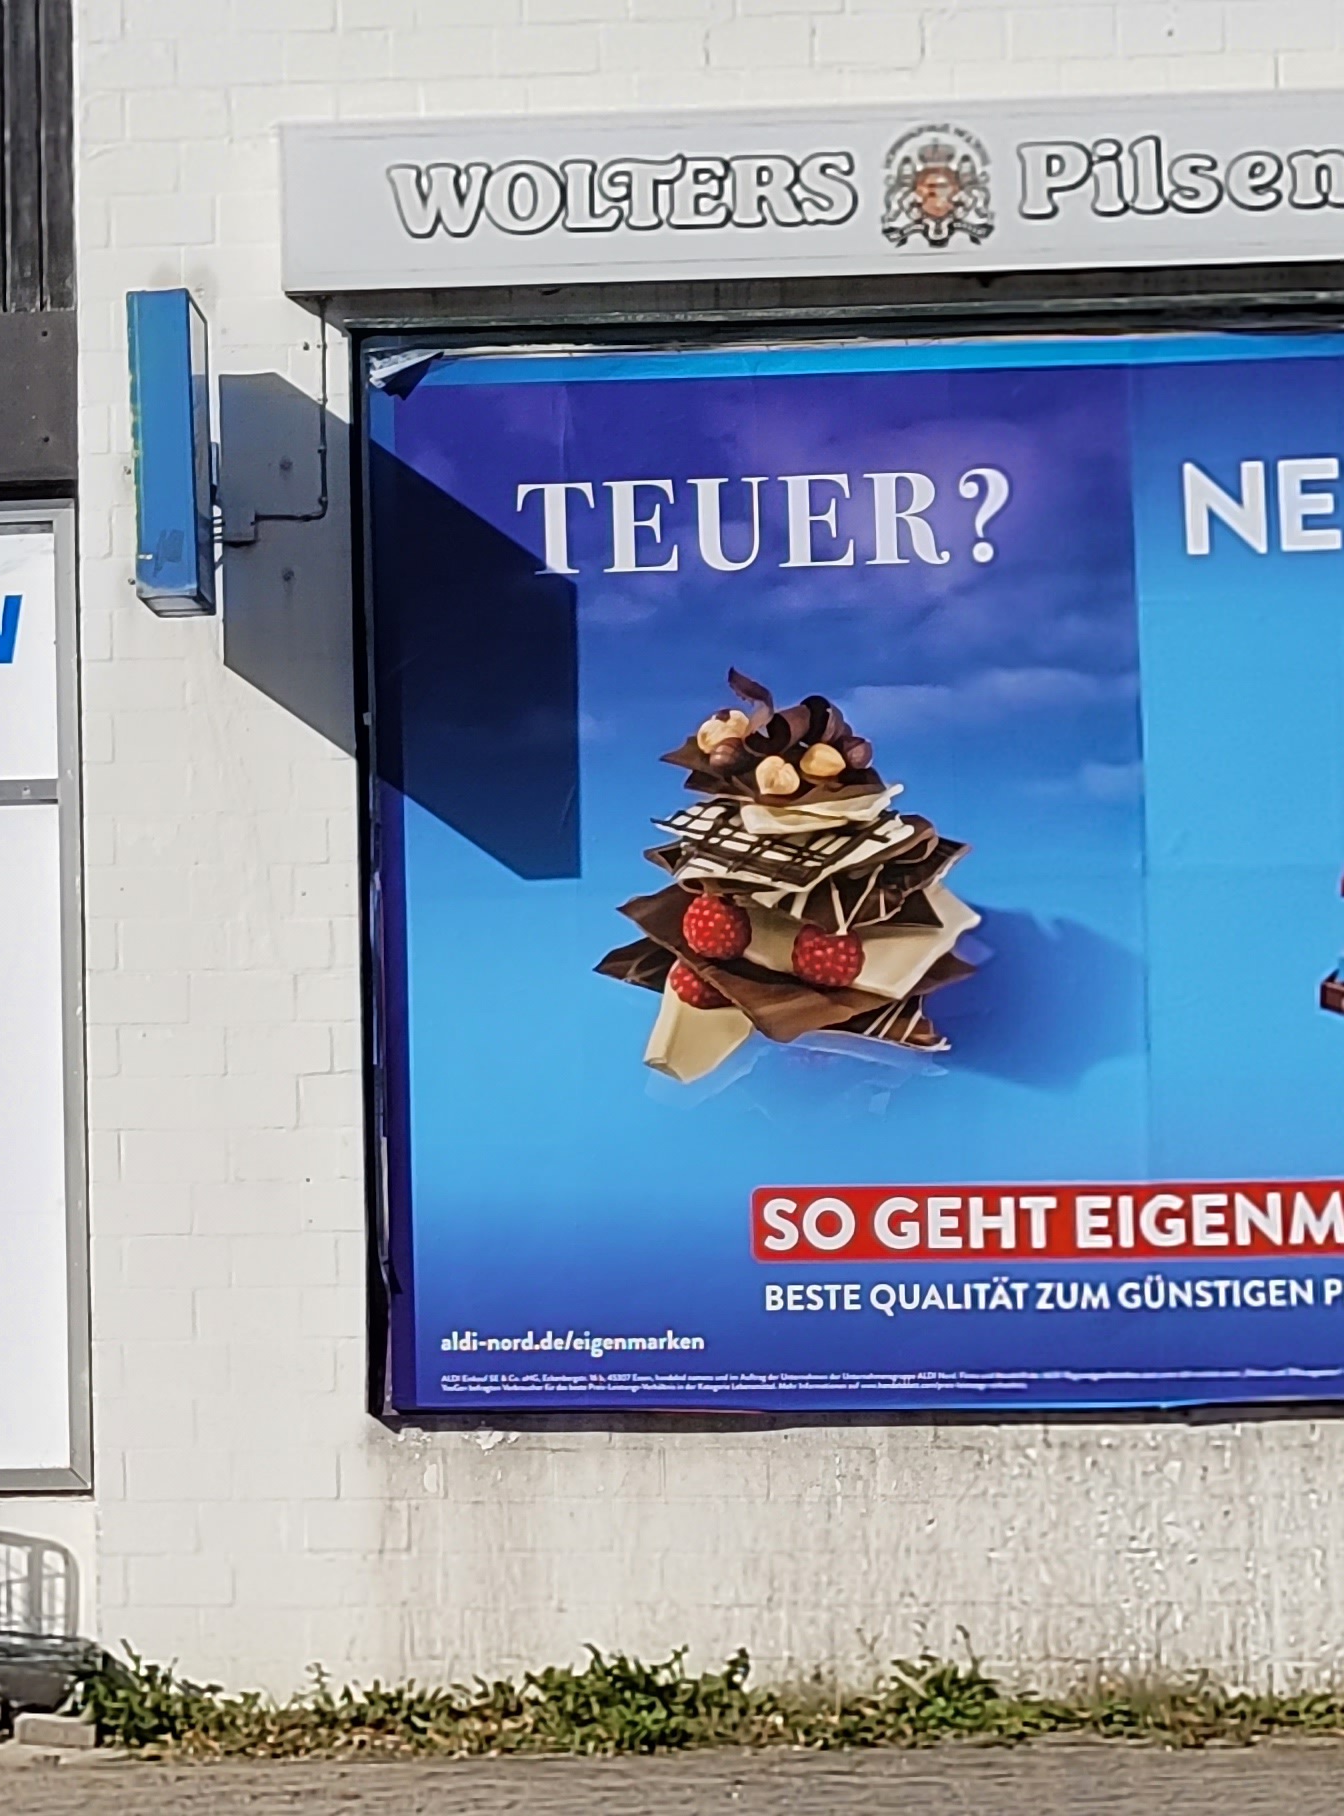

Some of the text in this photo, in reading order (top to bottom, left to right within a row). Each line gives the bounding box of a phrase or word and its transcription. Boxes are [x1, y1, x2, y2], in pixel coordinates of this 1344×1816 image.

[386, 151, 858, 238] WOLTERS
[1017, 135, 1344, 219] Pilsen
[516, 468, 1009, 575] TEUER?
[1183, 457, 1341, 555] NE
[763, 1191, 1344, 1251] SO GEHT EIGENM
[765, 1284, 862, 1312] BESTE
[869, 1276, 1030, 1317] QUALITÄT
[1035, 1282, 1111, 1311] ZUM
[1117, 1274, 1314, 1309] GÜNSTIGEN
[441, 1329, 706, 1358] aldi-nord.de/eigenmarken
